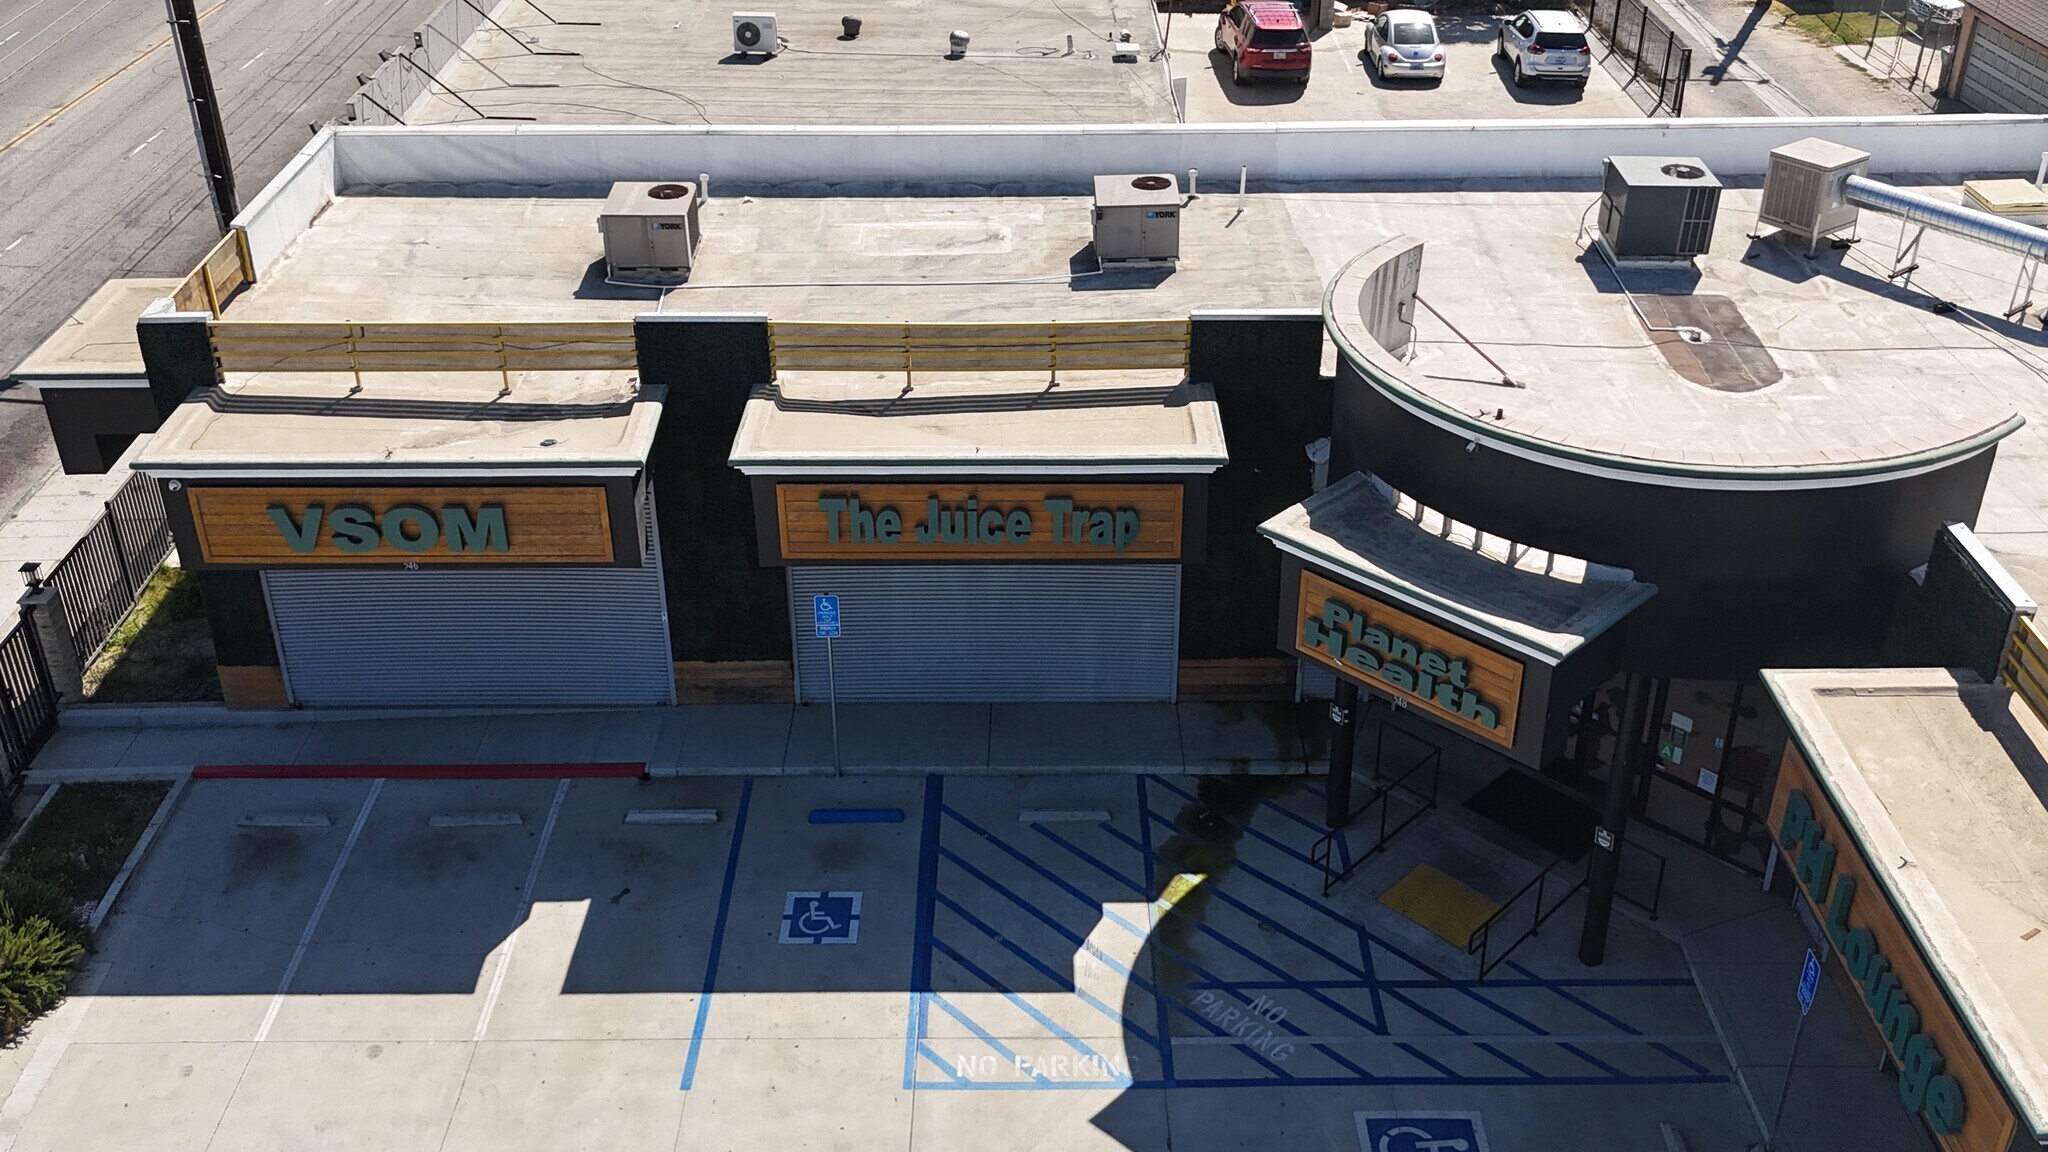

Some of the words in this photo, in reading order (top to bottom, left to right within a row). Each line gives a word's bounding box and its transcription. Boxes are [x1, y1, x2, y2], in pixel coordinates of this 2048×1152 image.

[660, 222, 682, 231] YORK
[1155, 210, 1177, 219] YORK
[266, 502, 510, 553] VSOM
[818, 493, 901, 545] The
[915, 494, 1032, 545] Juice
[1044, 495, 1139, 554] Trap
[1323, 598, 1471, 688] Planet
[1305, 616, 1499, 730] Health
[1779, 789, 1835, 904] PH
[1826, 873, 1968, 1136] Lounge
[1191, 990, 1296, 1061] PARKING
[1246, 994, 1288, 1024] NO
[956, 1055, 998, 1078] NO
